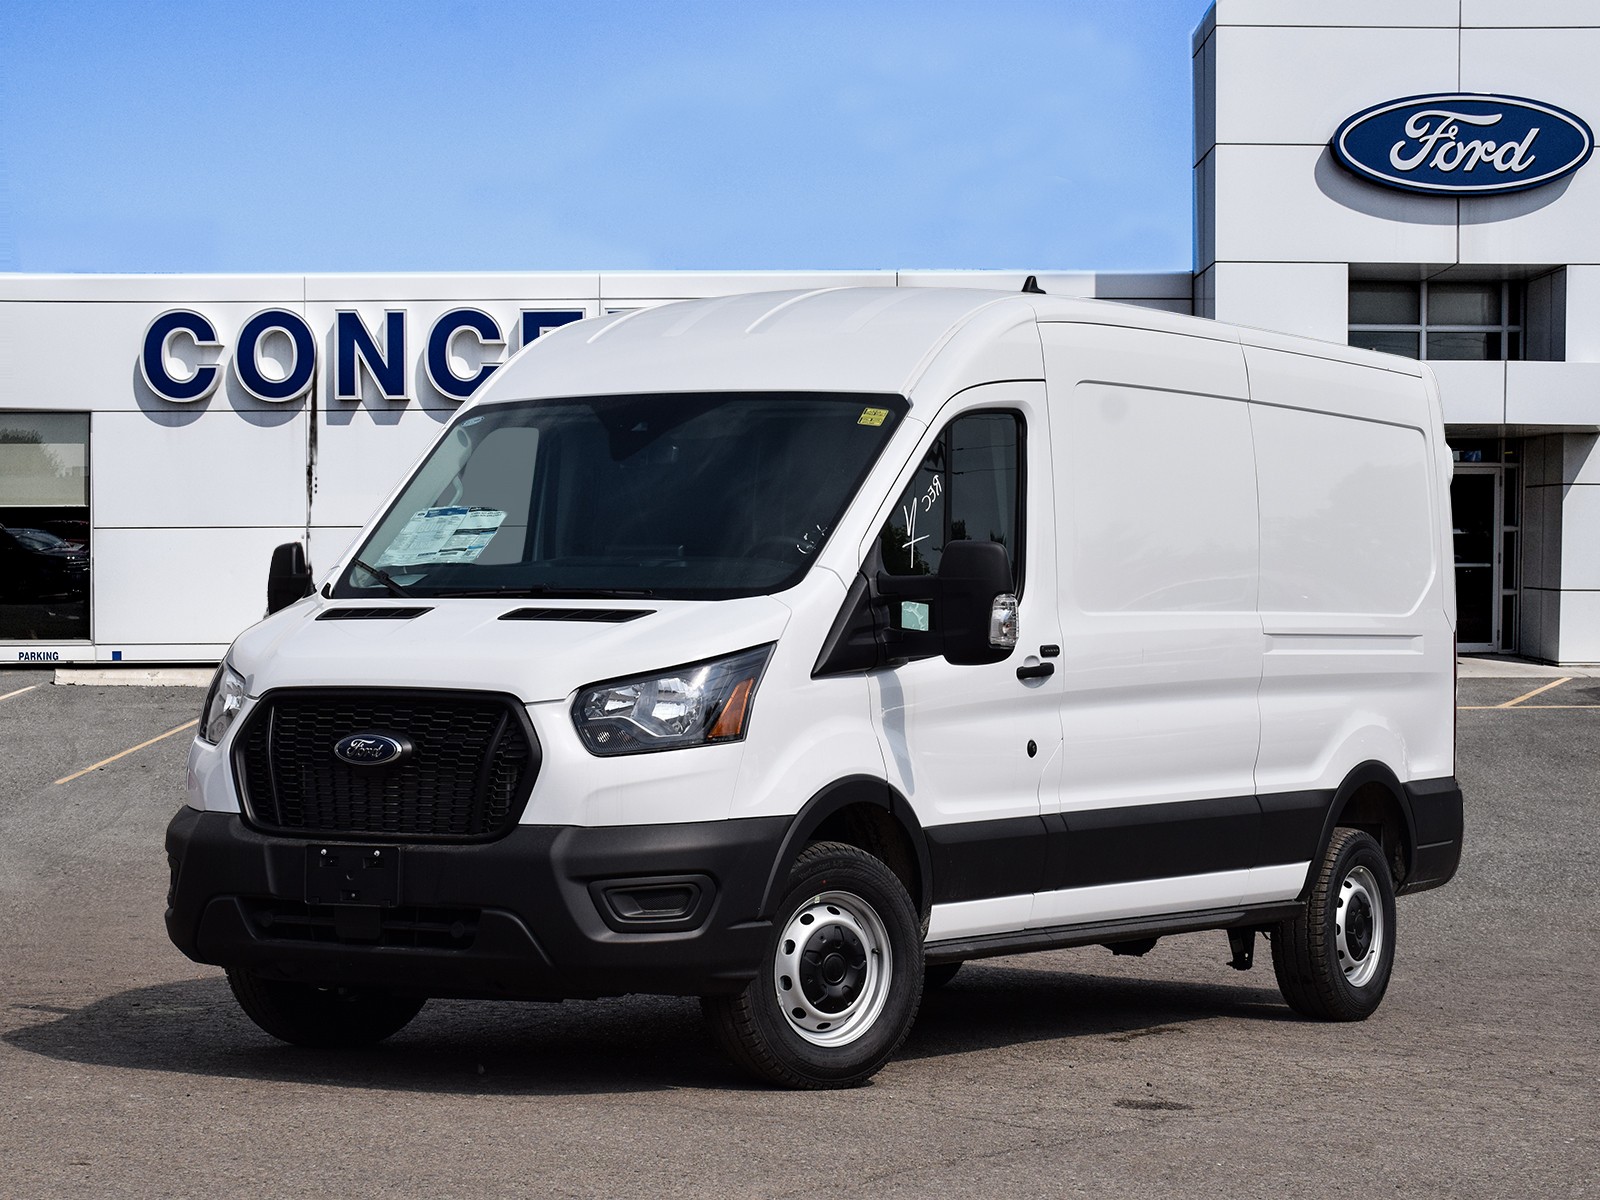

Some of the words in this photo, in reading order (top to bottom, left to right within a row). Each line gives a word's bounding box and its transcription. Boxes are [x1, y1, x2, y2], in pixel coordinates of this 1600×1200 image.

[1389, 109, 1540, 172] Ford
[18, 651, 59, 661] PARKING
[346, 738, 384, 758] Ford
